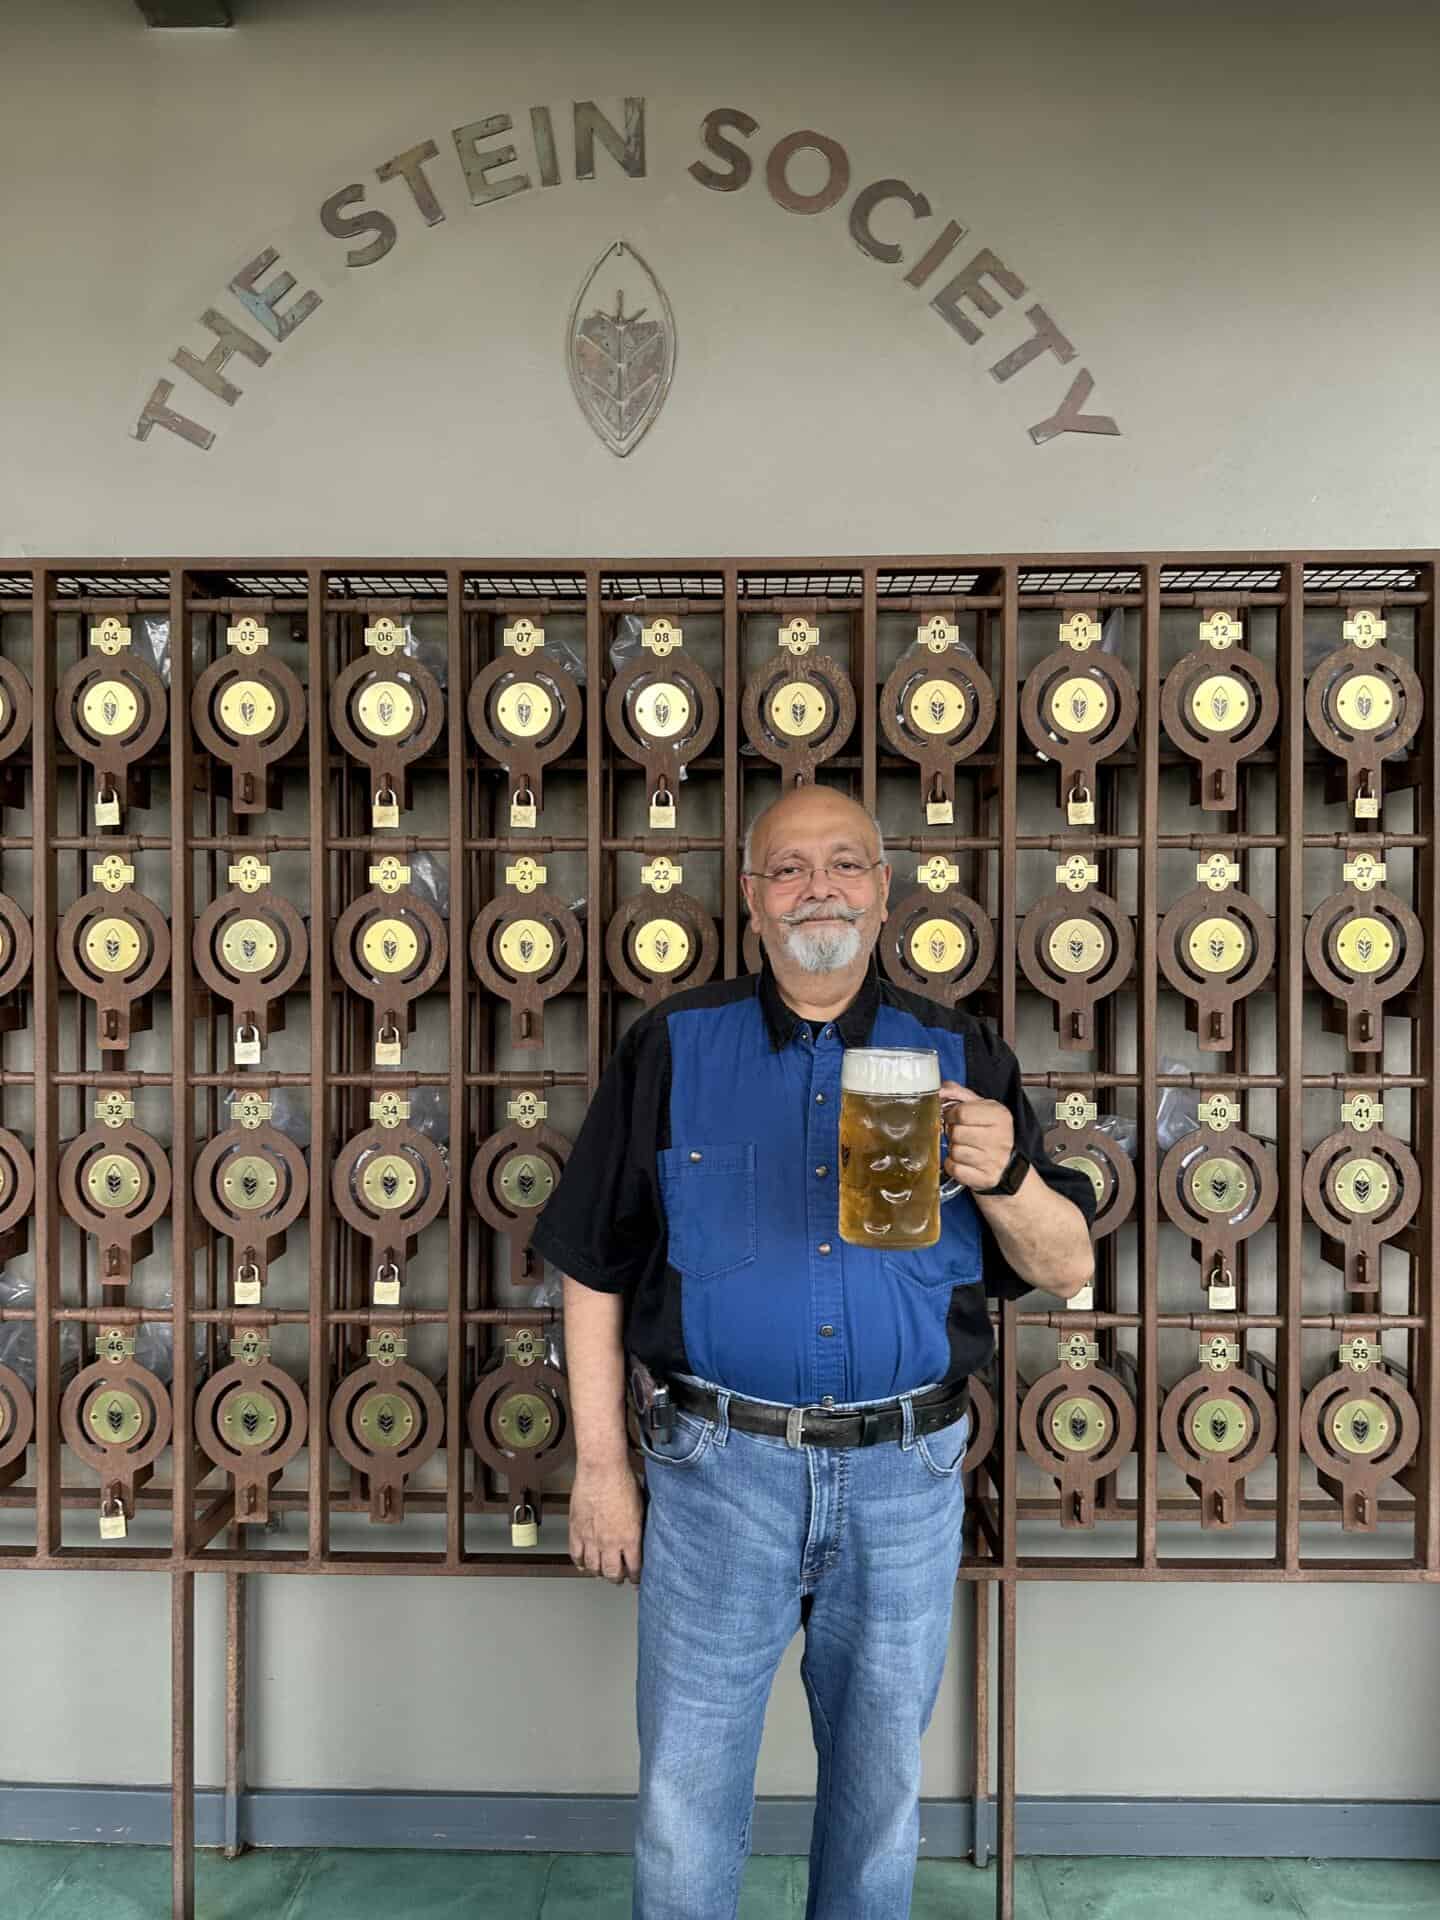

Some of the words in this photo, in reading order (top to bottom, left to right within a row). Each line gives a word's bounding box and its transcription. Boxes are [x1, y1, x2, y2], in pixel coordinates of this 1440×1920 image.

[130, 246, 323, 451] THE
[319, 96, 648, 268] STEIN
[687, 106, 1121, 445] SOCIETY
[930, 629, 946, 640] 10
[1073, 626, 1088, 637] 11
[1213, 625, 1229, 637] 12
[1356, 624, 1372, 636] 13
[103, 631, 119, 642] 04
[240, 630, 255, 642] 05
[377, 631, 393, 642] 06
[516, 632, 532, 643] 07
[654, 632, 670, 643] 08
[791, 631, 807, 643] 09
[106, 868, 121, 880] 18
[241, 869, 257, 881] 19
[382, 869, 398, 881] 20
[519, 870, 534, 881] 21
[654, 869, 670, 881] 22
[930, 869, 946, 880] 24
[1069, 868, 1085, 880] 25
[1210, 867, 1226, 878] 26
[1356, 866, 1373, 878] 27
[107, 1104, 123, 1115] 32
[243, 1105, 260, 1117] 33
[382, 1105, 398, 1116] 34
[519, 1104, 536, 1116] 35
[1068, 1105, 1085, 1117] 39
[1210, 1107, 1227, 1118] 40
[1354, 1108, 1370, 1119] 41
[107, 1340, 124, 1352] 46
[242, 1342, 259, 1353] 47
[378, 1342, 395, 1354] 48
[517, 1342, 534, 1353] 49
[1069, 1346, 1087, 1357] 53
[1211, 1347, 1227, 1358] 54
[1352, 1348, 1369, 1359] 55
